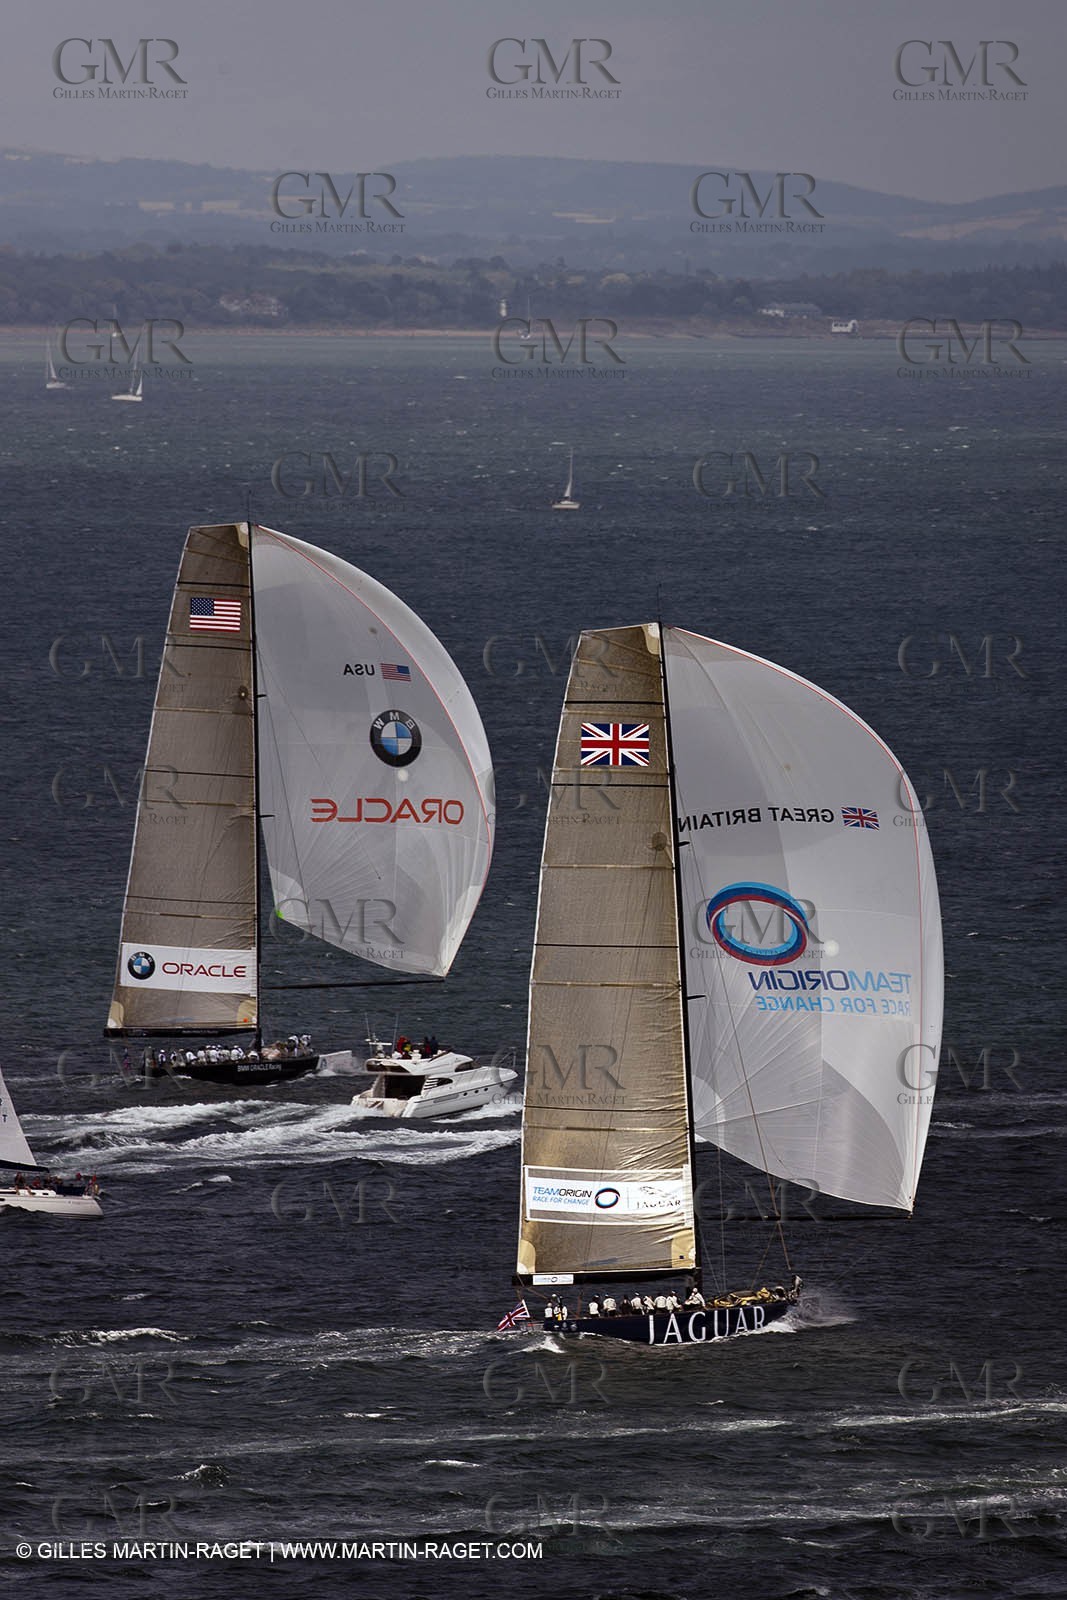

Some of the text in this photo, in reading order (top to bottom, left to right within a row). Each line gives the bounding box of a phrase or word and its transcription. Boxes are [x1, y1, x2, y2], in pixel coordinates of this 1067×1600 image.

[162, 962, 247, 978] ORACLE
[533, 1186, 593, 1198] TEAMORIGIN
[563, 1197, 590, 1205] CHANGE
[649, 1305, 766, 1345] JAGUAR
